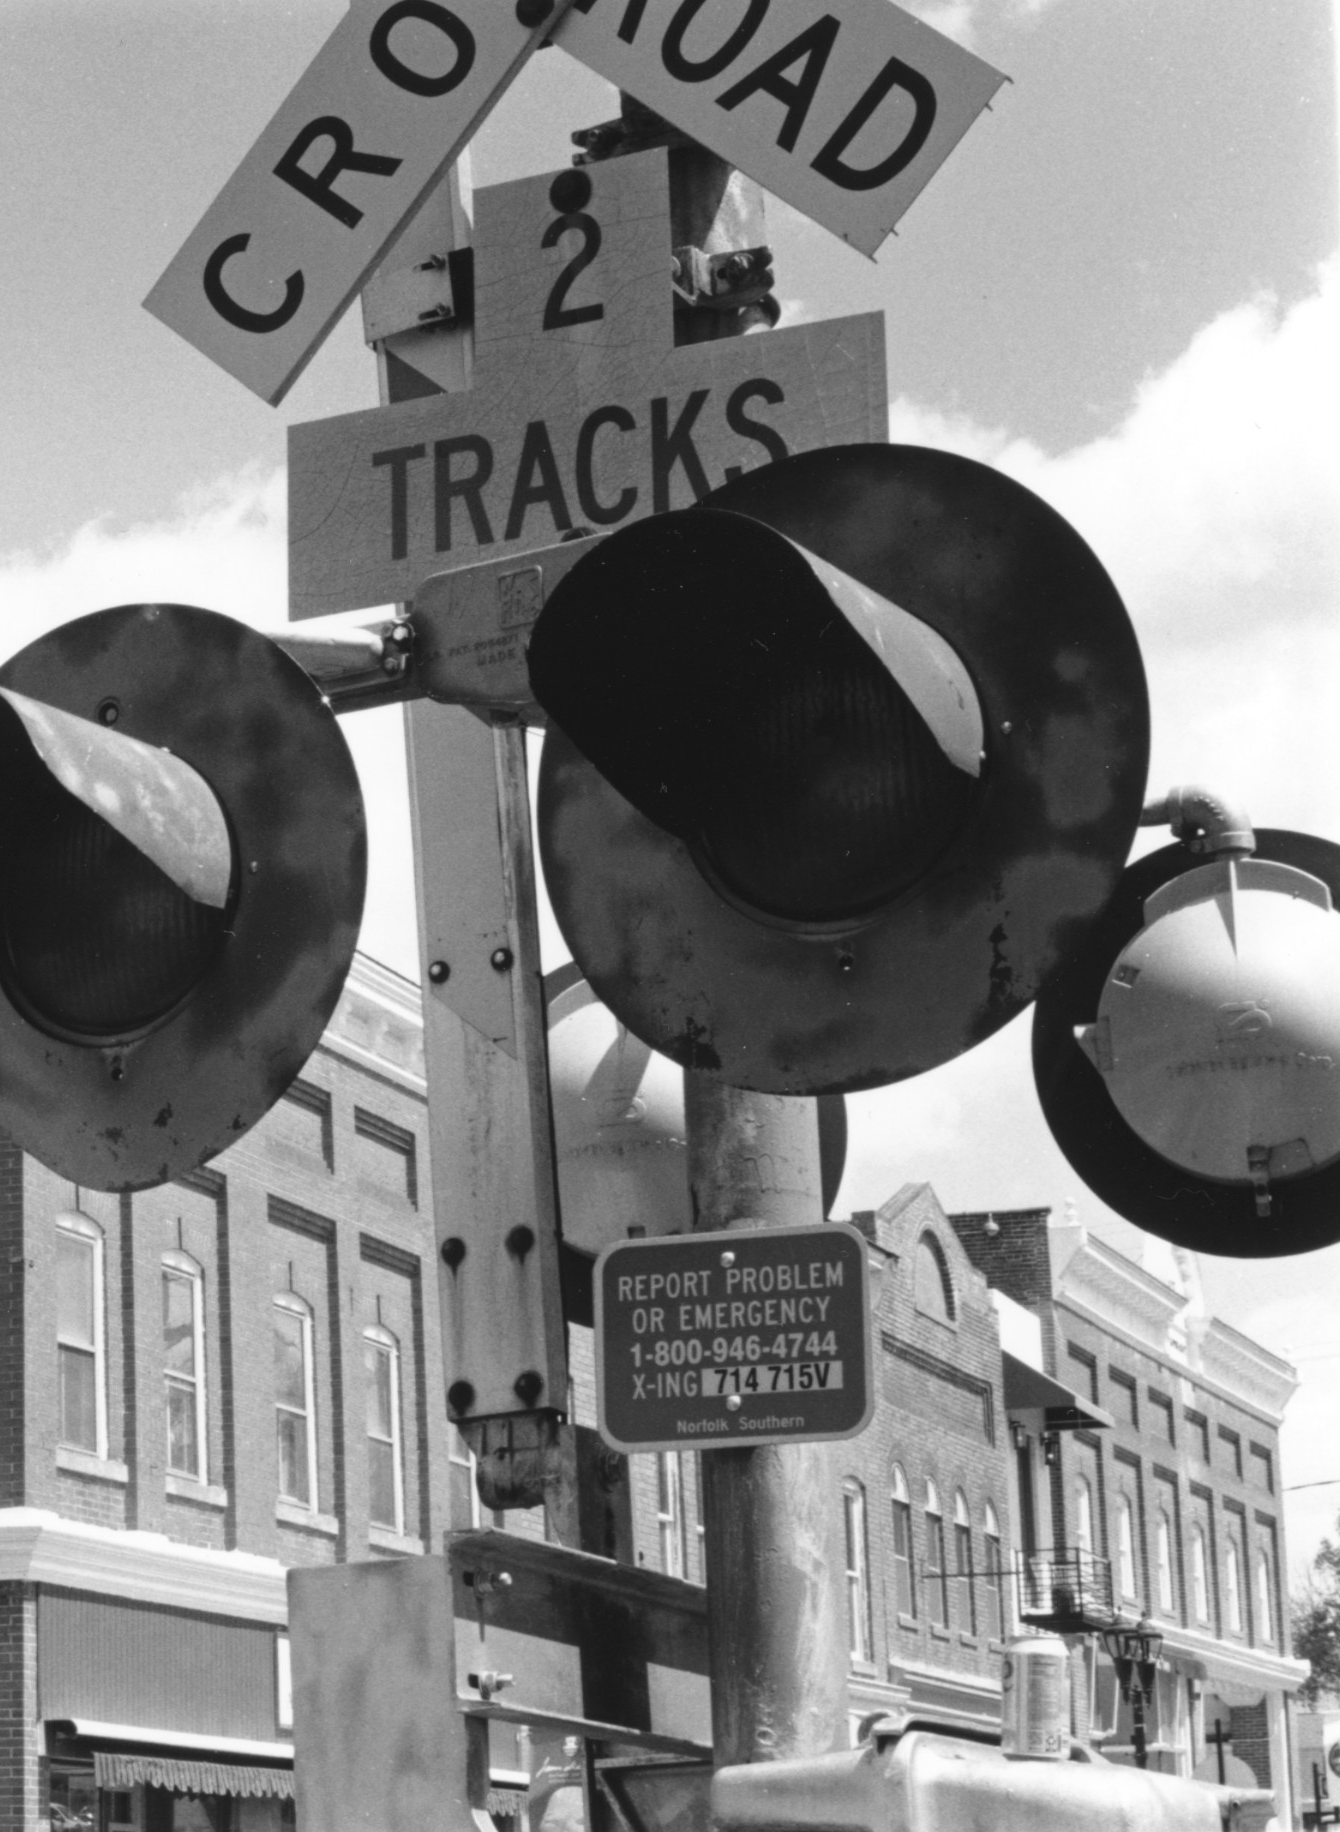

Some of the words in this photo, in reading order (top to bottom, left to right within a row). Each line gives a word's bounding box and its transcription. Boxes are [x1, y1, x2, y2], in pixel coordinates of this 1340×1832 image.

[540, 211, 604, 332] 2
[372, 378, 792, 560] TRACKS
[618, 1270, 711, 1301] REPORT
[726, 1261, 843, 1294] PROBLEM
[632, 1307, 664, 1334] OR
[679, 1296, 831, 1331] EMERGENCY
[630, 1330, 838, 1367] 1-800-946-4744
[632, 1371, 698, 1399] X-ING
[714, 1367, 759, 1393] 714
[767, 1362, 831, 1391] 715V
[677, 1418, 729, 1433] Norfolk
[739, 1415, 804, 1430] Southern
